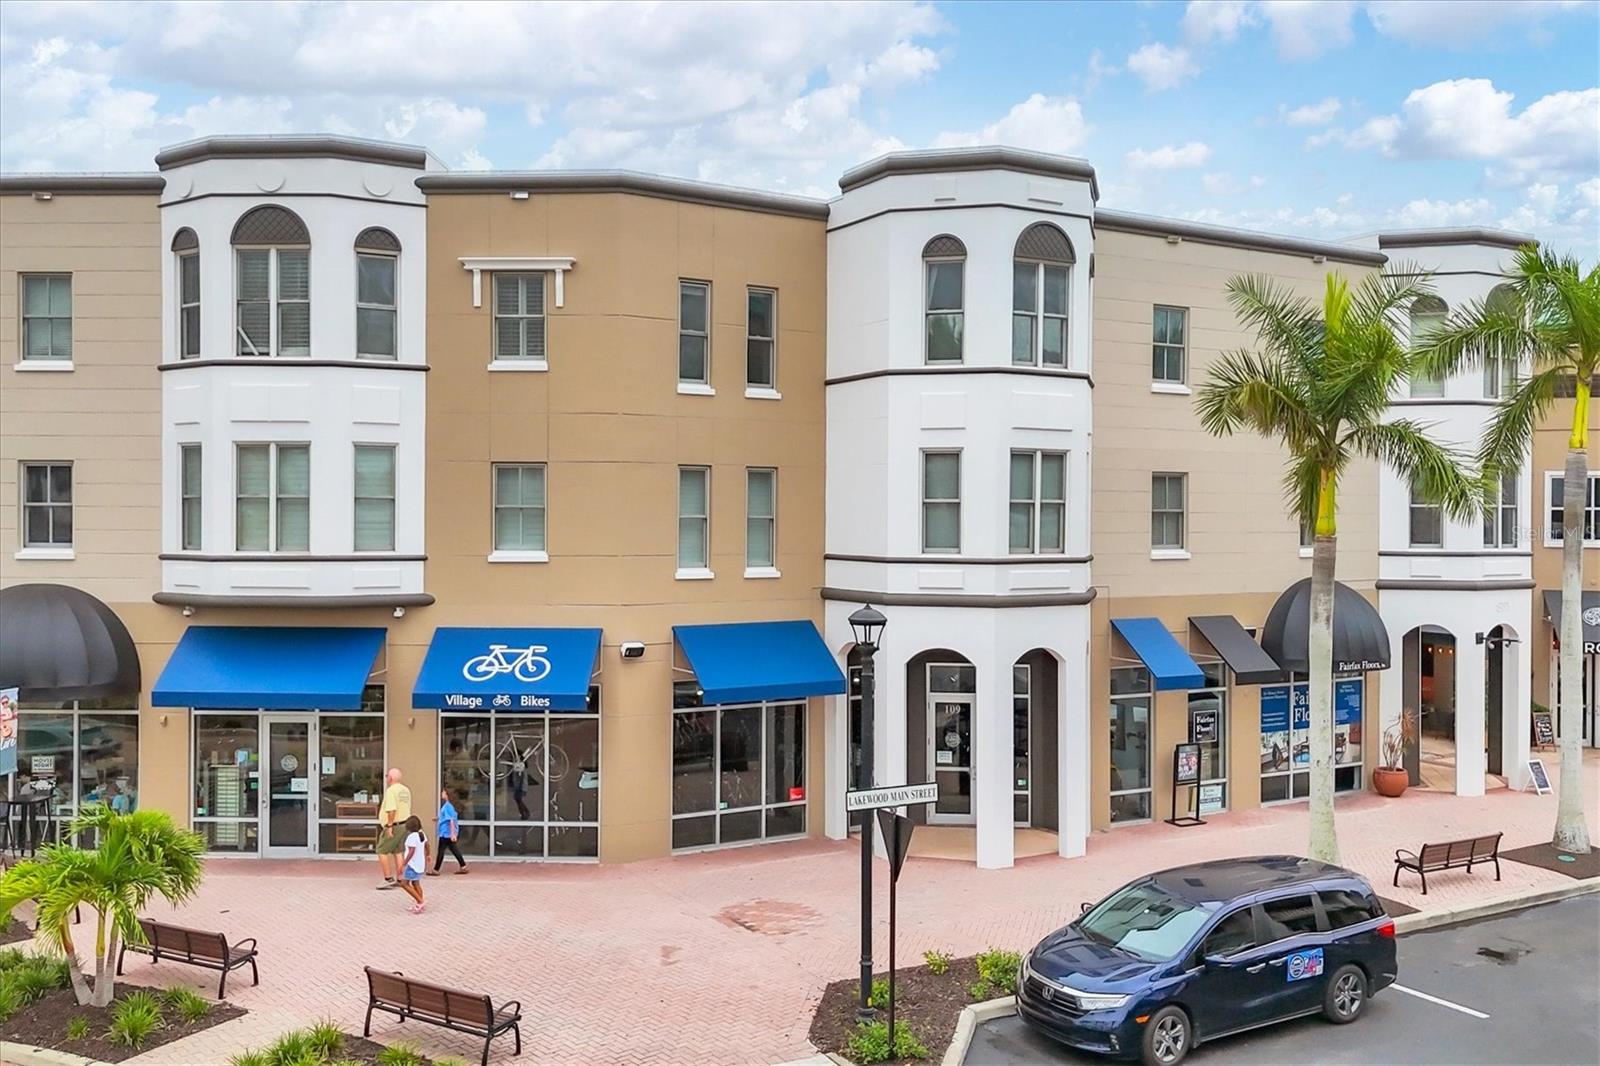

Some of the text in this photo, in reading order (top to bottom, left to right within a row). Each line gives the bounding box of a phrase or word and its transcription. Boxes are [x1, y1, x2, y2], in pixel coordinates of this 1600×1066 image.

[1339, 661, 1360, 671] Fairfax
[1362, 660, 1380, 670] Floors
[445, 695, 550, 709] Village Bikes
[1293, 690, 1309, 706] Fai
[945, 705, 961, 714] 109
[1294, 708, 1310, 723] Flo
[848, 788, 936, 807] LAKEWOOD MAIN STREET
